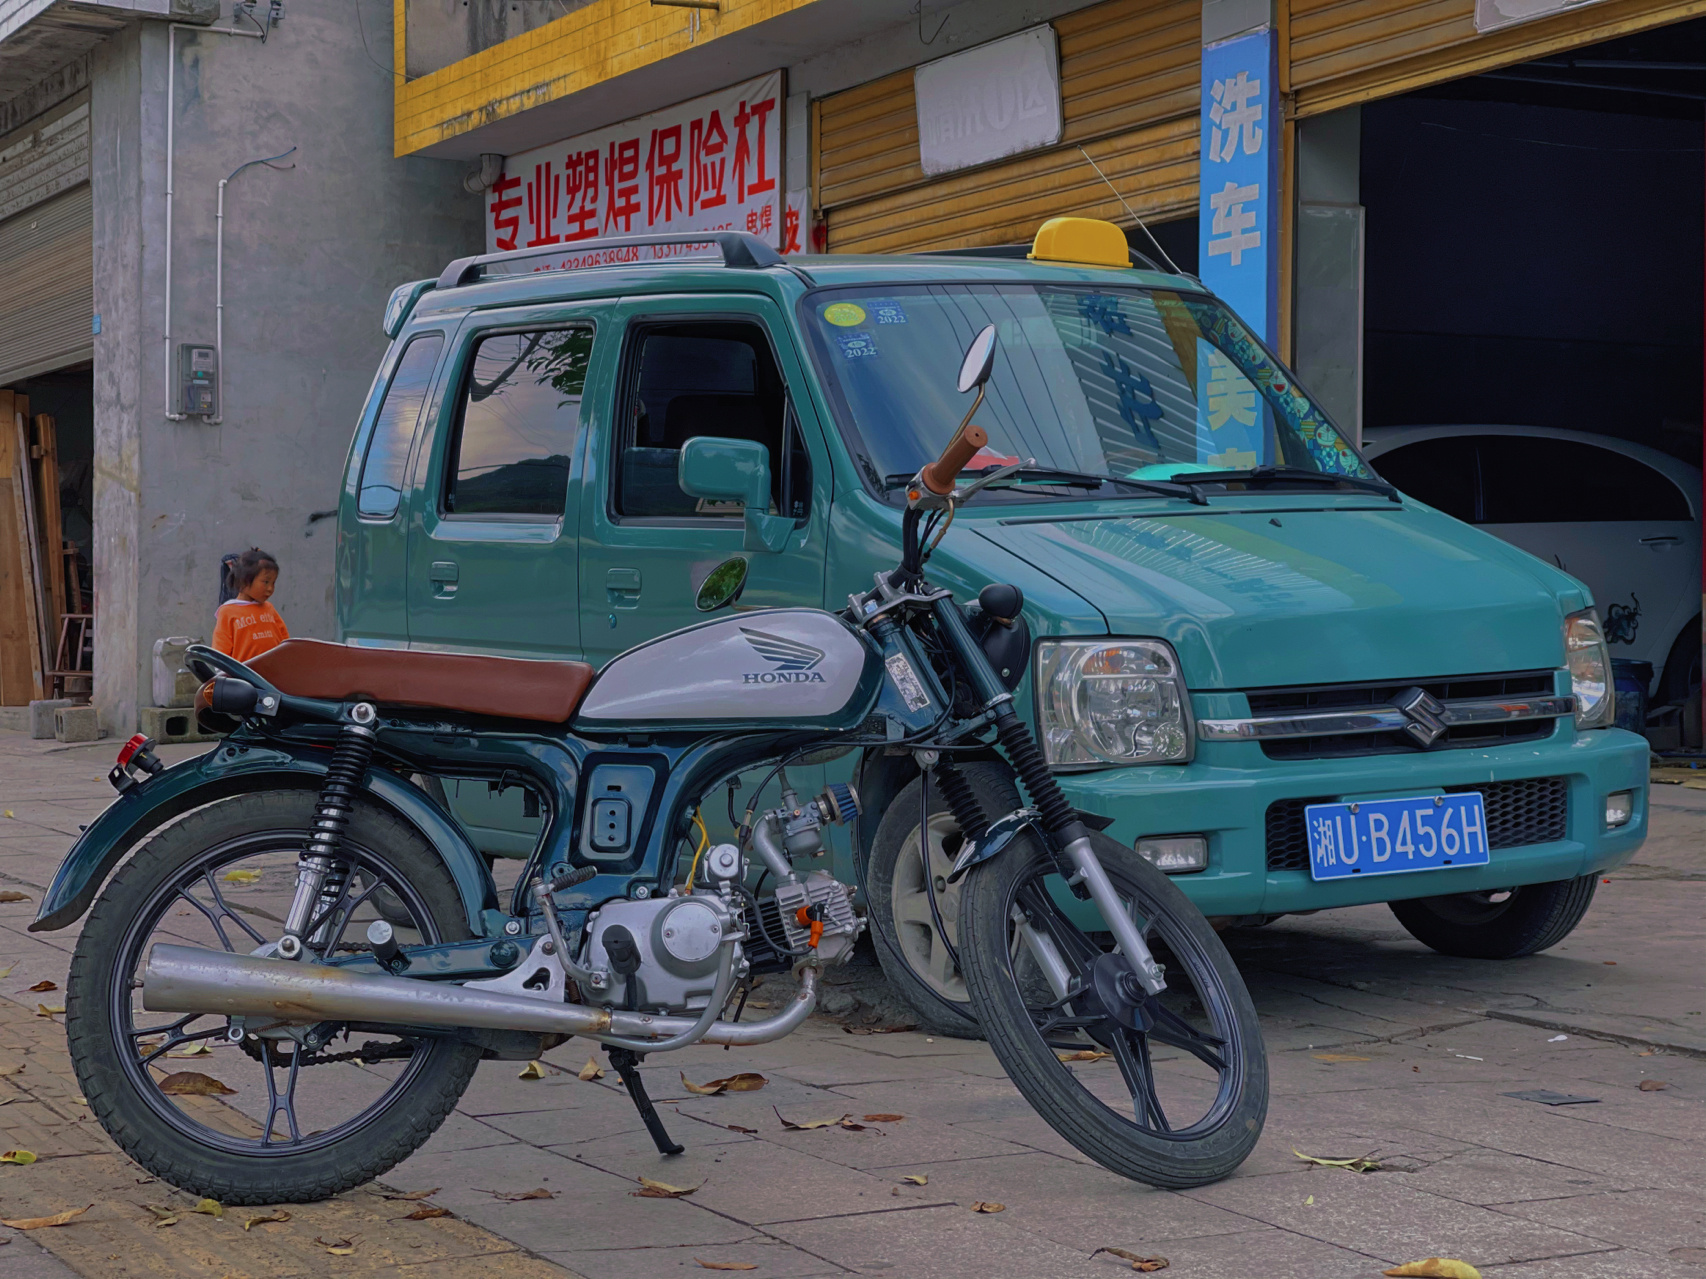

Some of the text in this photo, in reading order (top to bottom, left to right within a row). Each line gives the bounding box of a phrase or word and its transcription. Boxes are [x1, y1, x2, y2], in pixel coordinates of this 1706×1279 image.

[490, 97, 776, 251] 专业塑焊保险杠
[1208, 71, 1263, 267] 洗车
[746, 204, 773, 235] 电焊
[877, 315, 906, 324] 2022
[846, 347, 877, 358] 2022
[743, 672, 826, 684] HONDA
